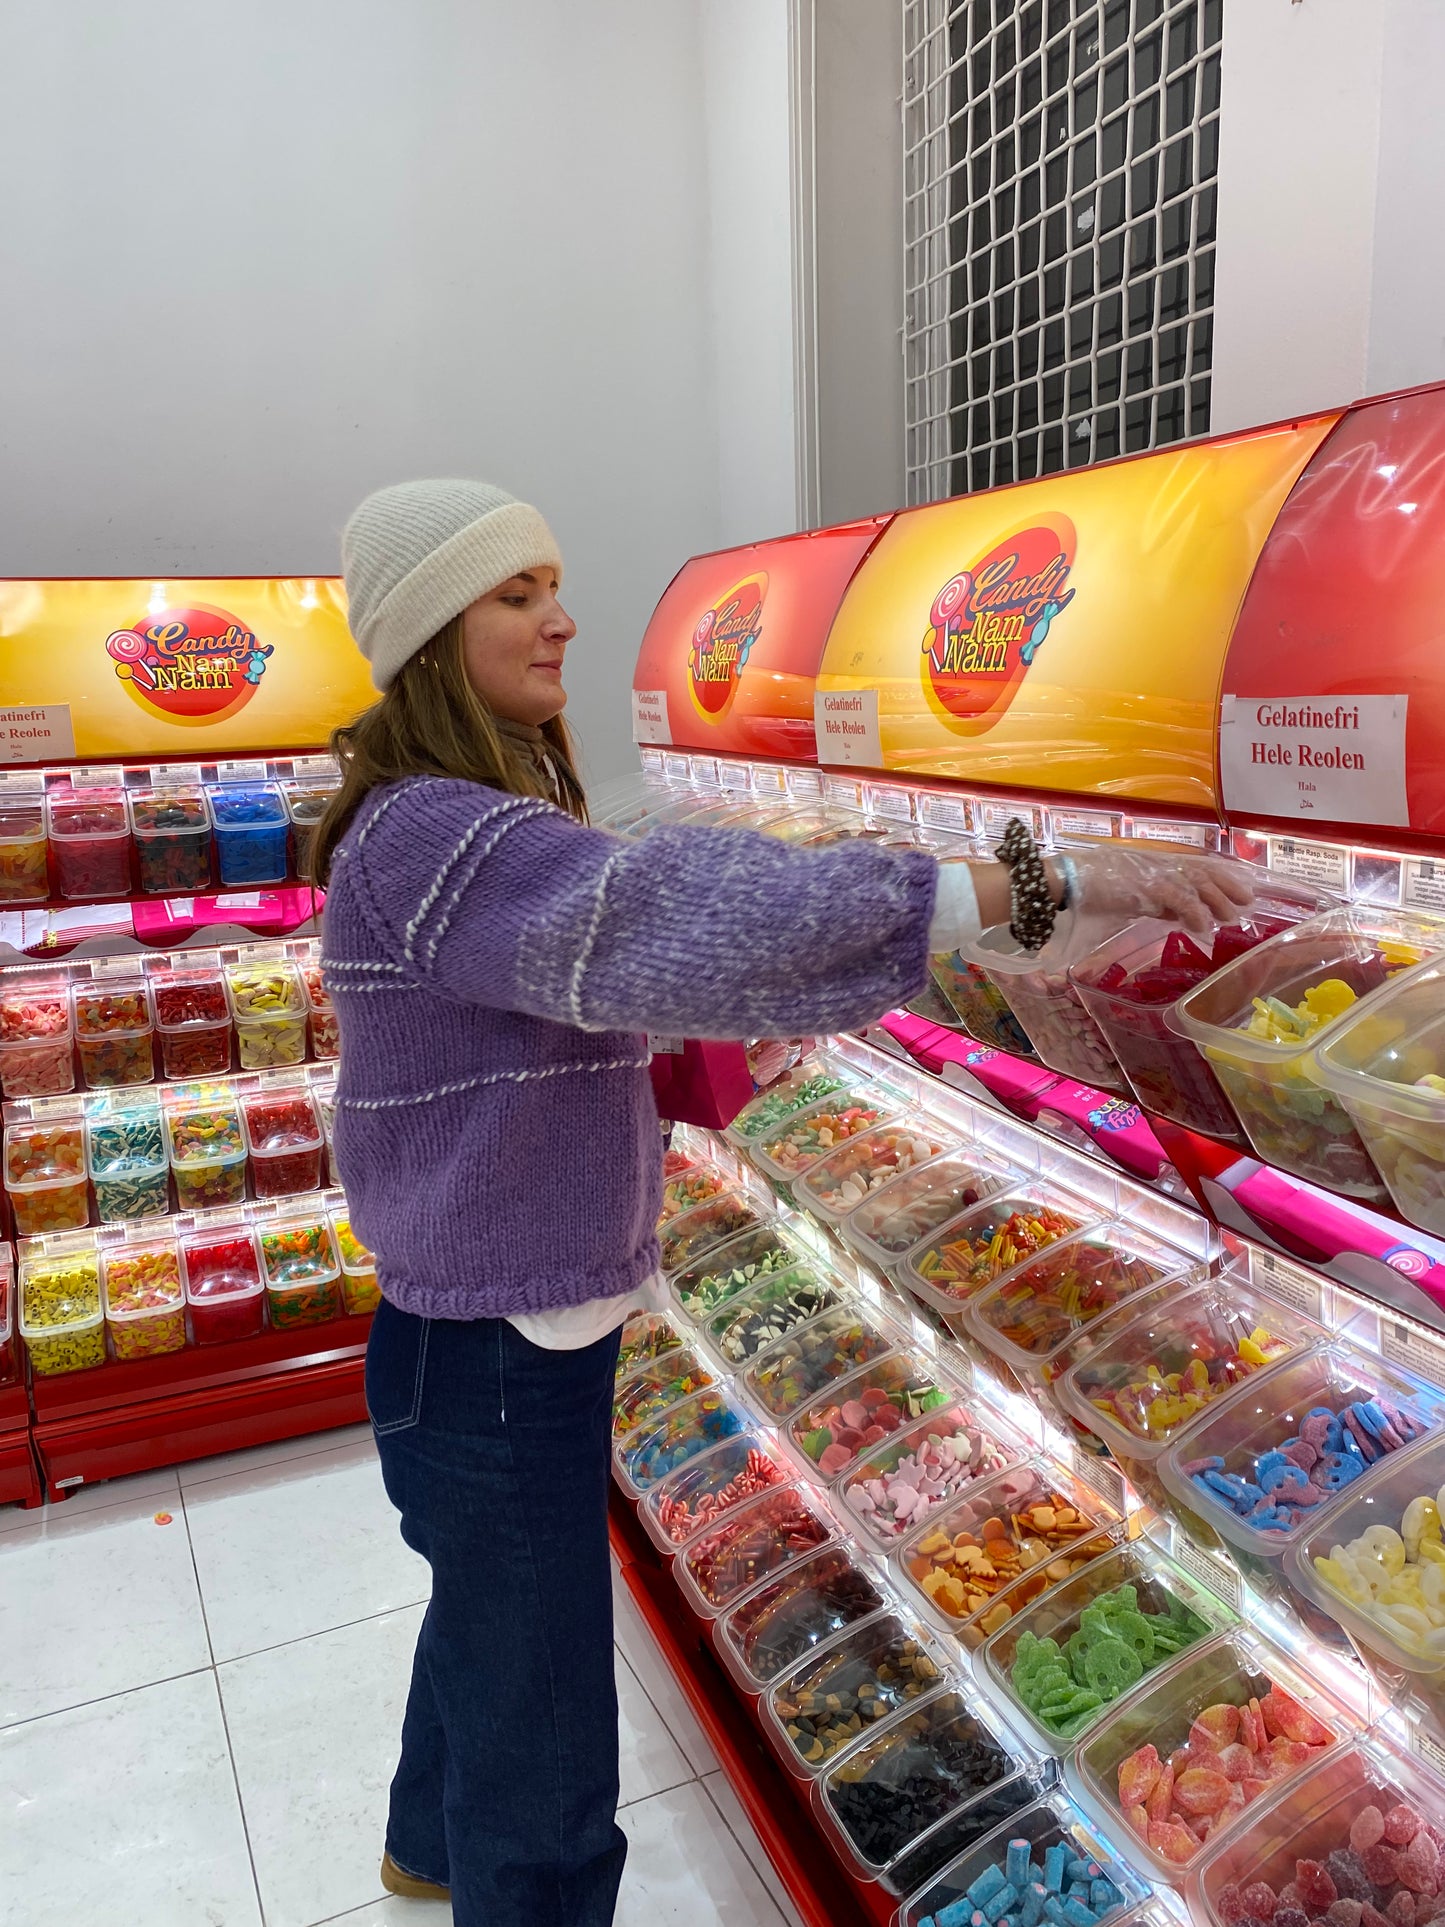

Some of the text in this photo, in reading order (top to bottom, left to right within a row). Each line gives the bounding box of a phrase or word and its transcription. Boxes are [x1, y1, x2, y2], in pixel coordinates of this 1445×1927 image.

[968, 553, 1073, 617] Candy
[711, 600, 761, 645] Candy
[967, 611, 1026, 644] Nam
[146, 621, 270, 659] Candy
[711, 639, 738, 661] Nam
[174, 654, 240, 673] Nam
[941, 635, 1008, 673] Nam
[154, 667, 233, 691] Nam
[699, 654, 731, 682] Nam
[824, 696, 862, 711] Gelatinefri
[825, 720, 866, 735] Hele Reolen
[1256, 704, 1360, 730] Gelatinefri
[9, 728, 51, 739] Reolen
[1251, 742, 1366, 771] Hele Reolen
[1298, 781, 1317, 792] Hala
[1323, 852, 1339, 860] Soda
